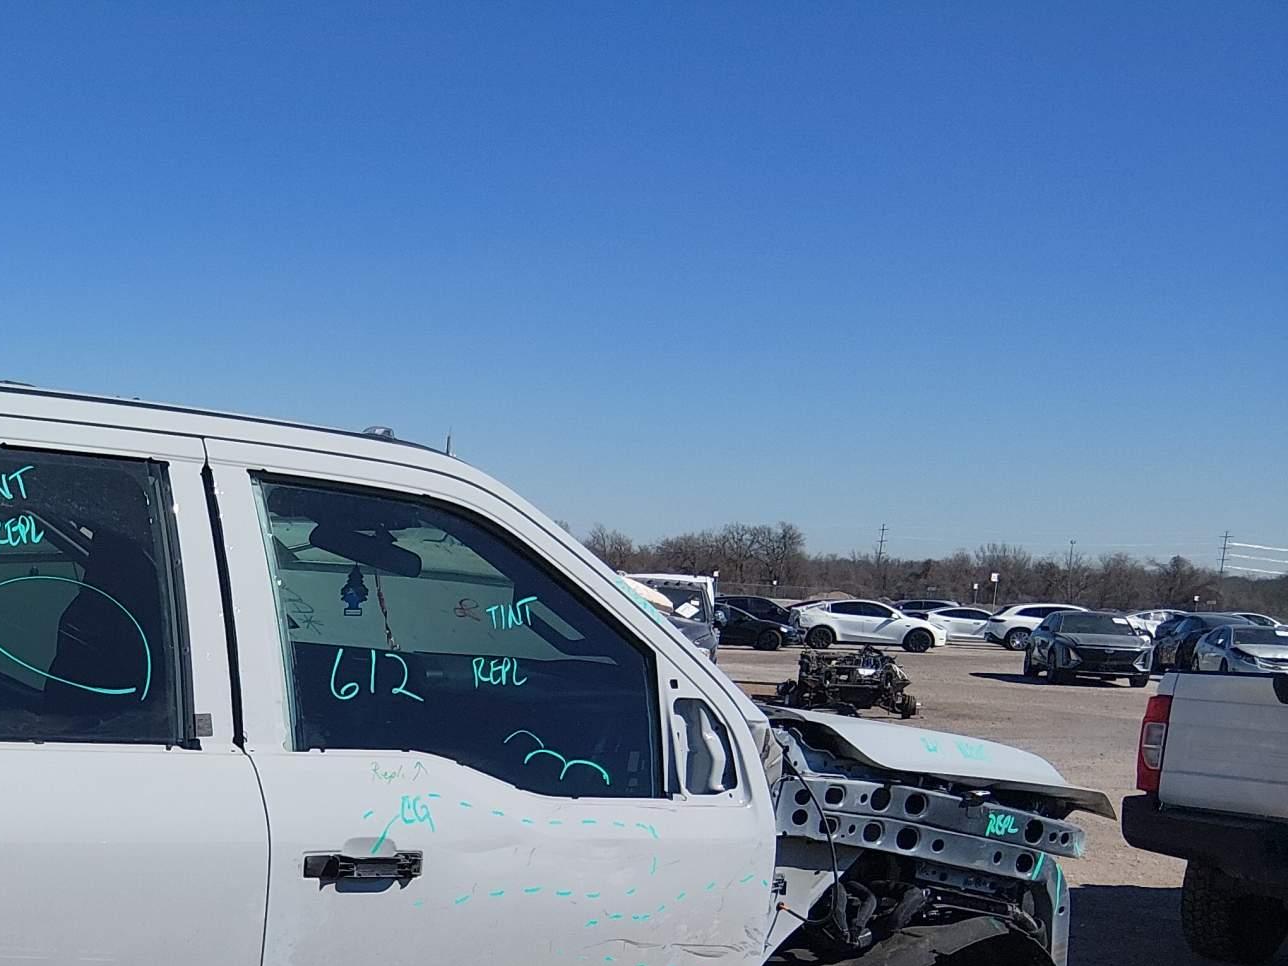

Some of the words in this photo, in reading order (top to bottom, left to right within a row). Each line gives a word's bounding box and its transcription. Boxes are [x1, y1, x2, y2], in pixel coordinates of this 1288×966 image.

[486, 596, 538, 630] TINT
[330, 648, 424, 702] 612
[472, 657, 528, 689] REPL
